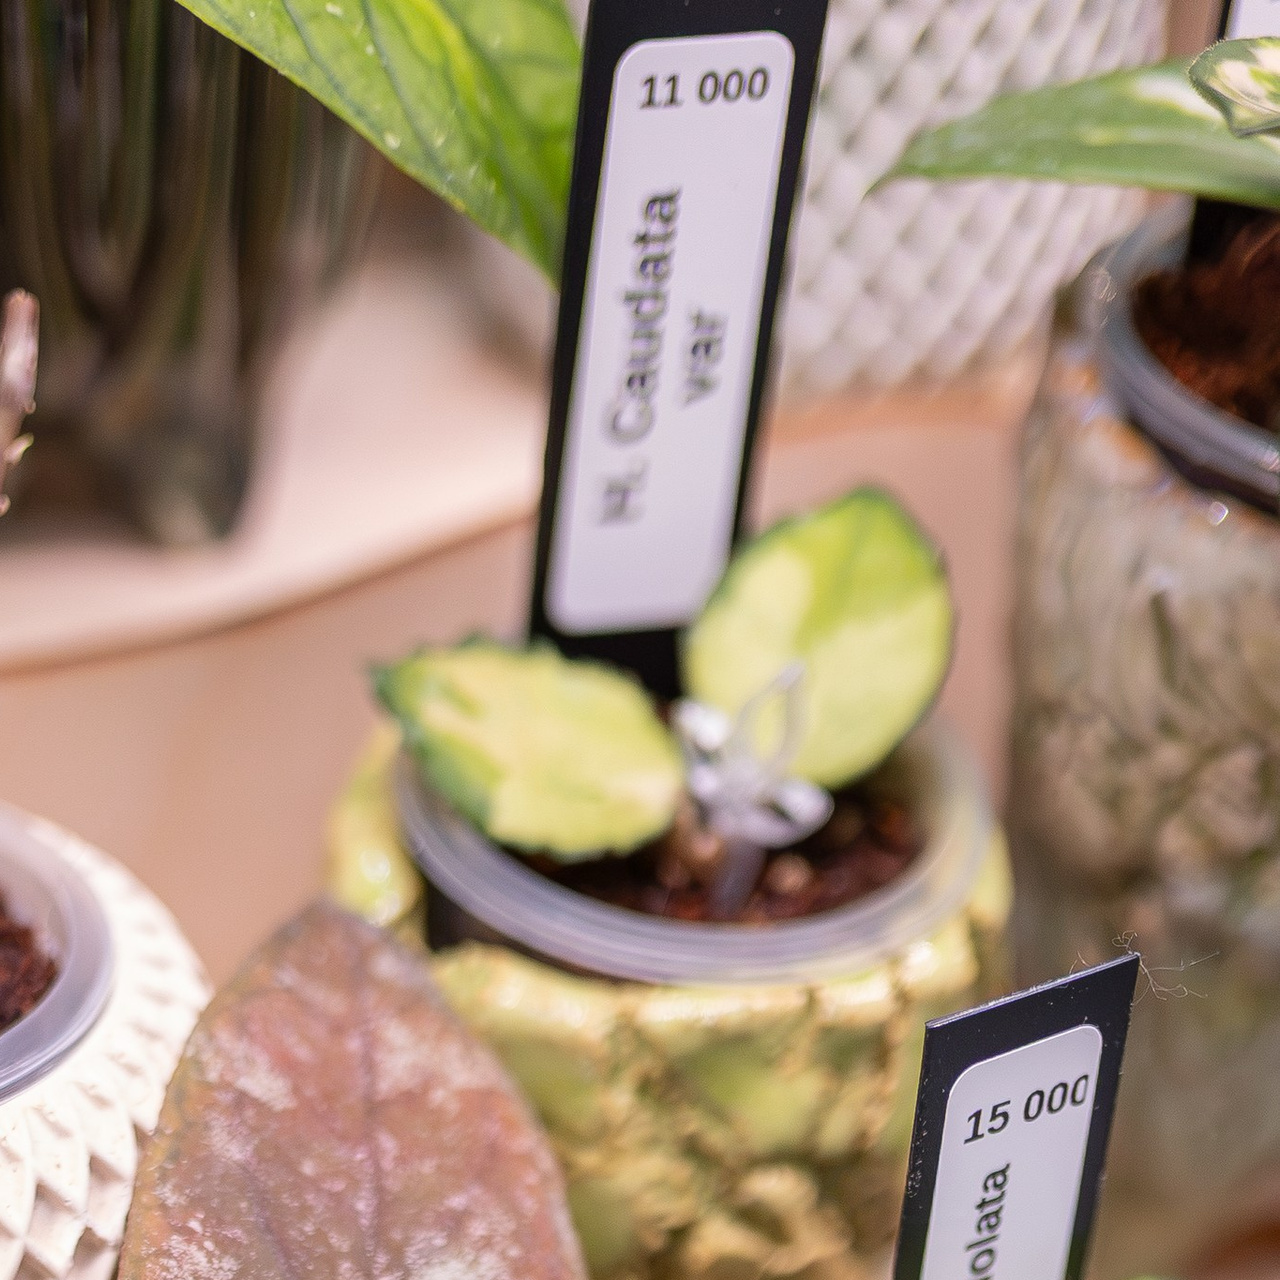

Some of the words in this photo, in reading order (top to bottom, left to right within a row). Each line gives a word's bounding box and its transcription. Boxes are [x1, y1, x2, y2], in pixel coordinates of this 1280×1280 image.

[639, 73, 683, 110] 11
[696, 65, 771, 105] 000
[606, 186, 682, 444] Caudata
[681, 309, 726, 407] var
[963, 1099, 1011, 1145] 15
[1022, 1073, 1090, 1123] 000
